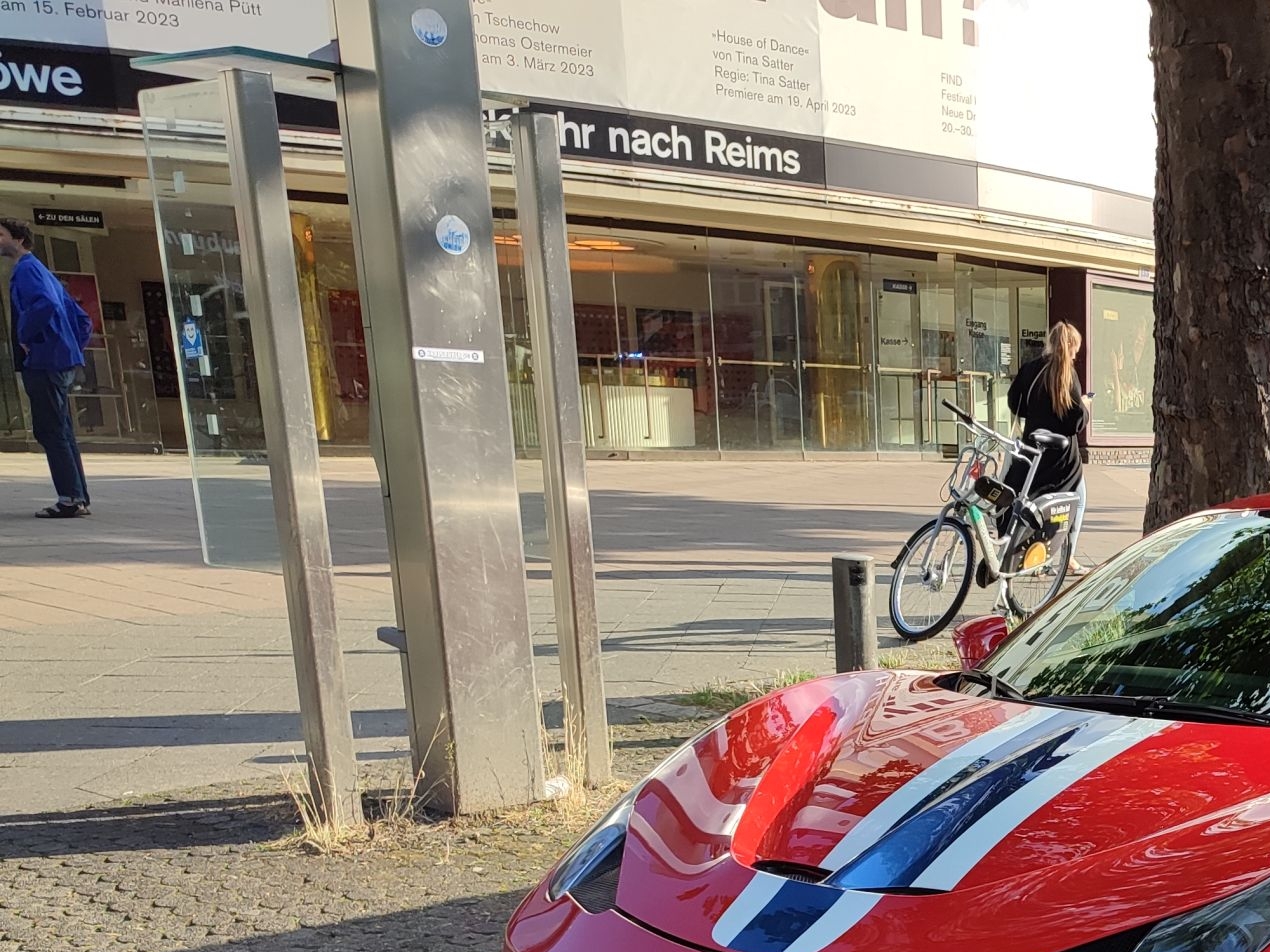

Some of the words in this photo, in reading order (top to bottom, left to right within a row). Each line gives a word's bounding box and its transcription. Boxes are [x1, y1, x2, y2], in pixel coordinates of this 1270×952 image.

[1, 1, 25, 12] am
[35, 0, 59, 15] 15.
[65, 2, 129, 22] Februar
[136, 11, 180, 27] 2023
[230, 0, 262, 16] Pütt
[484, 11, 560, 34] Tschechow
[520, 36, 593, 58] Ostermeier
[756, 37, 768, 50] of
[482, 53, 502, 65] am
[506, 54, 520, 67] 3.
[524, 56, 556, 73] März
[560, 61, 594, 77] 2023
[712, 51, 732, 63] von
[736, 51, 759, 67] Tina
[761, 56, 794, 72] Satter
[714, 65, 750, 83] Regie:
[752, 71, 776, 87] Tina
[778, 75, 811, 92] Satter
[941, 72, 963, 87] FIND
[715, 84, 764, 102] Premiere
[767, 94, 784, 105] am
[787, 95, 803, 108] 19.
[805, 98, 829, 113] April
[832, 103, 857, 117] 2023
[941, 89, 972, 105] Festival
[941, 104, 964, 119] Neue
[608, 125, 693, 161] nach
[704, 129, 800, 175] Reims
[75, 214, 100, 224] SÄLEN
[880, 336, 901, 346] Kasse
